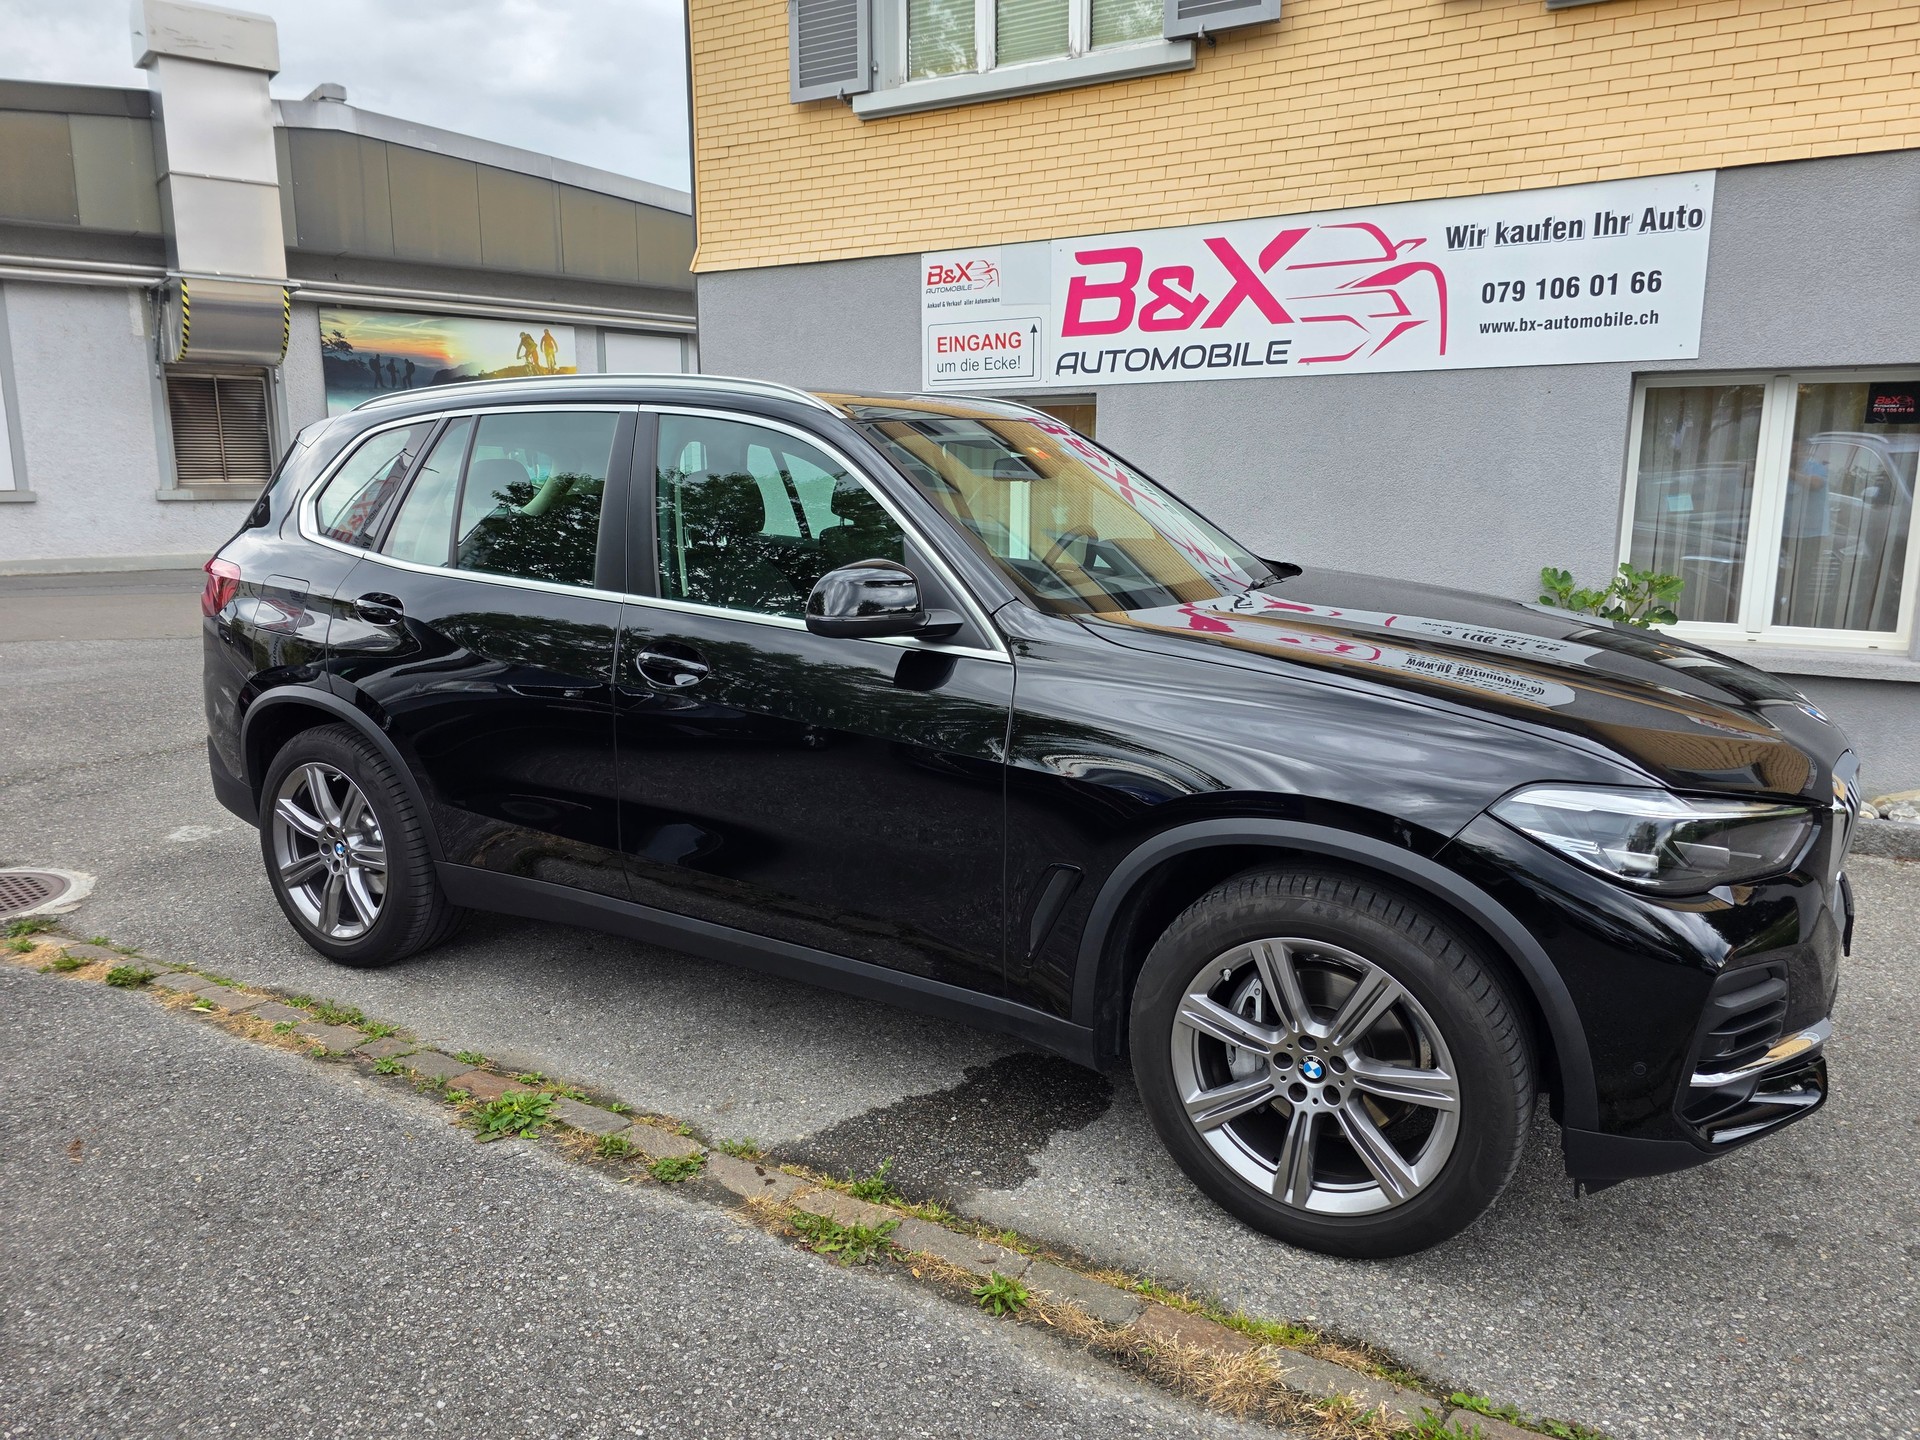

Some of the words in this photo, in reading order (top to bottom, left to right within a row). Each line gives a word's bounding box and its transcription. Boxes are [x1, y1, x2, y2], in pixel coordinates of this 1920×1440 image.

[1446, 224, 1488, 251] Wir
[1495, 214, 1585, 248] kaufen
[1594, 210, 1632, 238] Ihr
[1640, 204, 1704, 233] Auto
[927, 261, 974, 286] B&X
[1061, 227, 1312, 338] B&X
[926, 284, 973, 295] AUTOMOBILE
[1481, 280, 1526, 304] 079
[1535, 276, 1580, 301] 106
[1589, 272, 1618, 297] 01
[1630, 269, 1663, 294] 66
[1479, 310, 1660, 334] www.bx-automobile.ch
[937, 331, 1022, 353] EINGANG
[937, 363, 956, 373] um
[960, 358, 979, 372] die
[984, 355, 1021, 371] Ecke!
[1055, 339, 1293, 376] AUTOMOBILE
